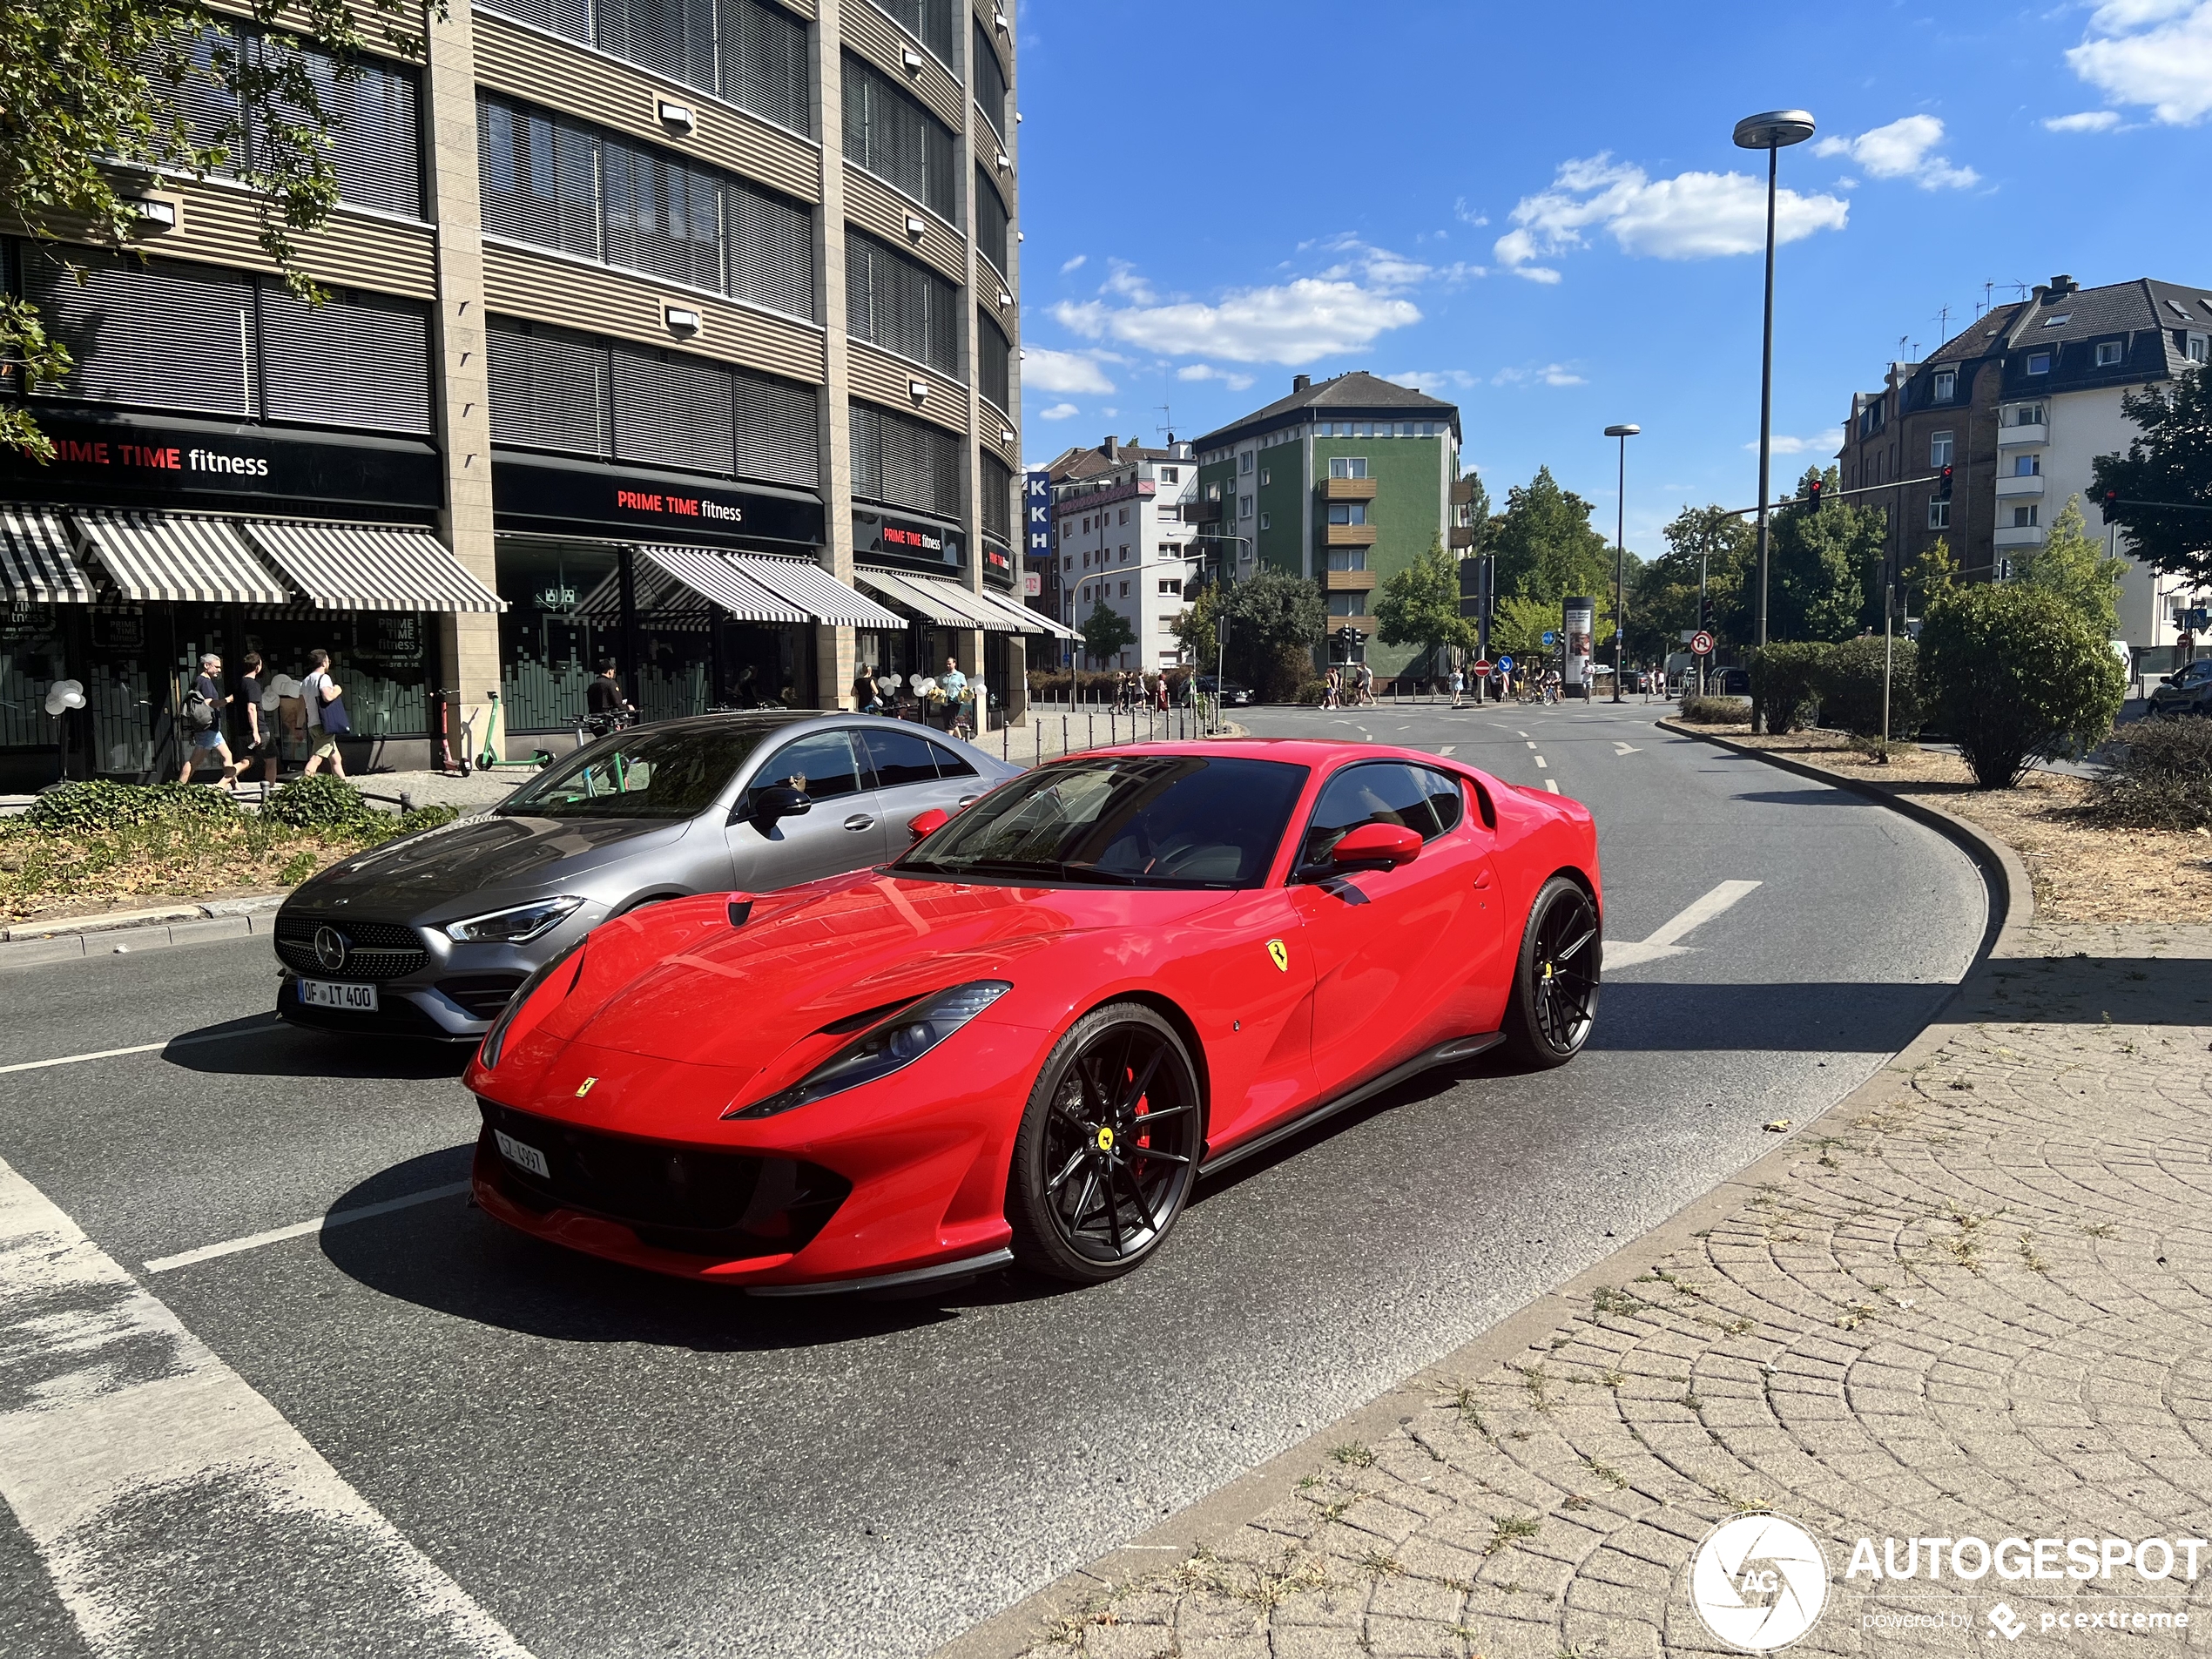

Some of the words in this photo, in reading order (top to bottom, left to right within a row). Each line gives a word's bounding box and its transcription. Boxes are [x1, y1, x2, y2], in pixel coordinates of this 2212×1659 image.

[118, 445, 181, 469] TIME
[189, 448, 269, 476] fitness
[617, 490, 663, 512] PRIME
[666, 496, 698, 516] TIME
[701, 500, 742, 522] fitness
[1030, 480, 1048, 549] KKH
[884, 527, 906, 544] PRIME
[906, 531, 921, 547] TIME
[921, 533, 941, 550] fitness
[13, 601, 45, 612] TIME
[378, 617, 415, 629] PRIME
[387, 629, 415, 640] TIME
[378, 638, 415, 651] fitness
[305, 981, 317, 1002] OF
[328, 985, 342, 1006] IT
[347, 987, 371, 1008] 400
